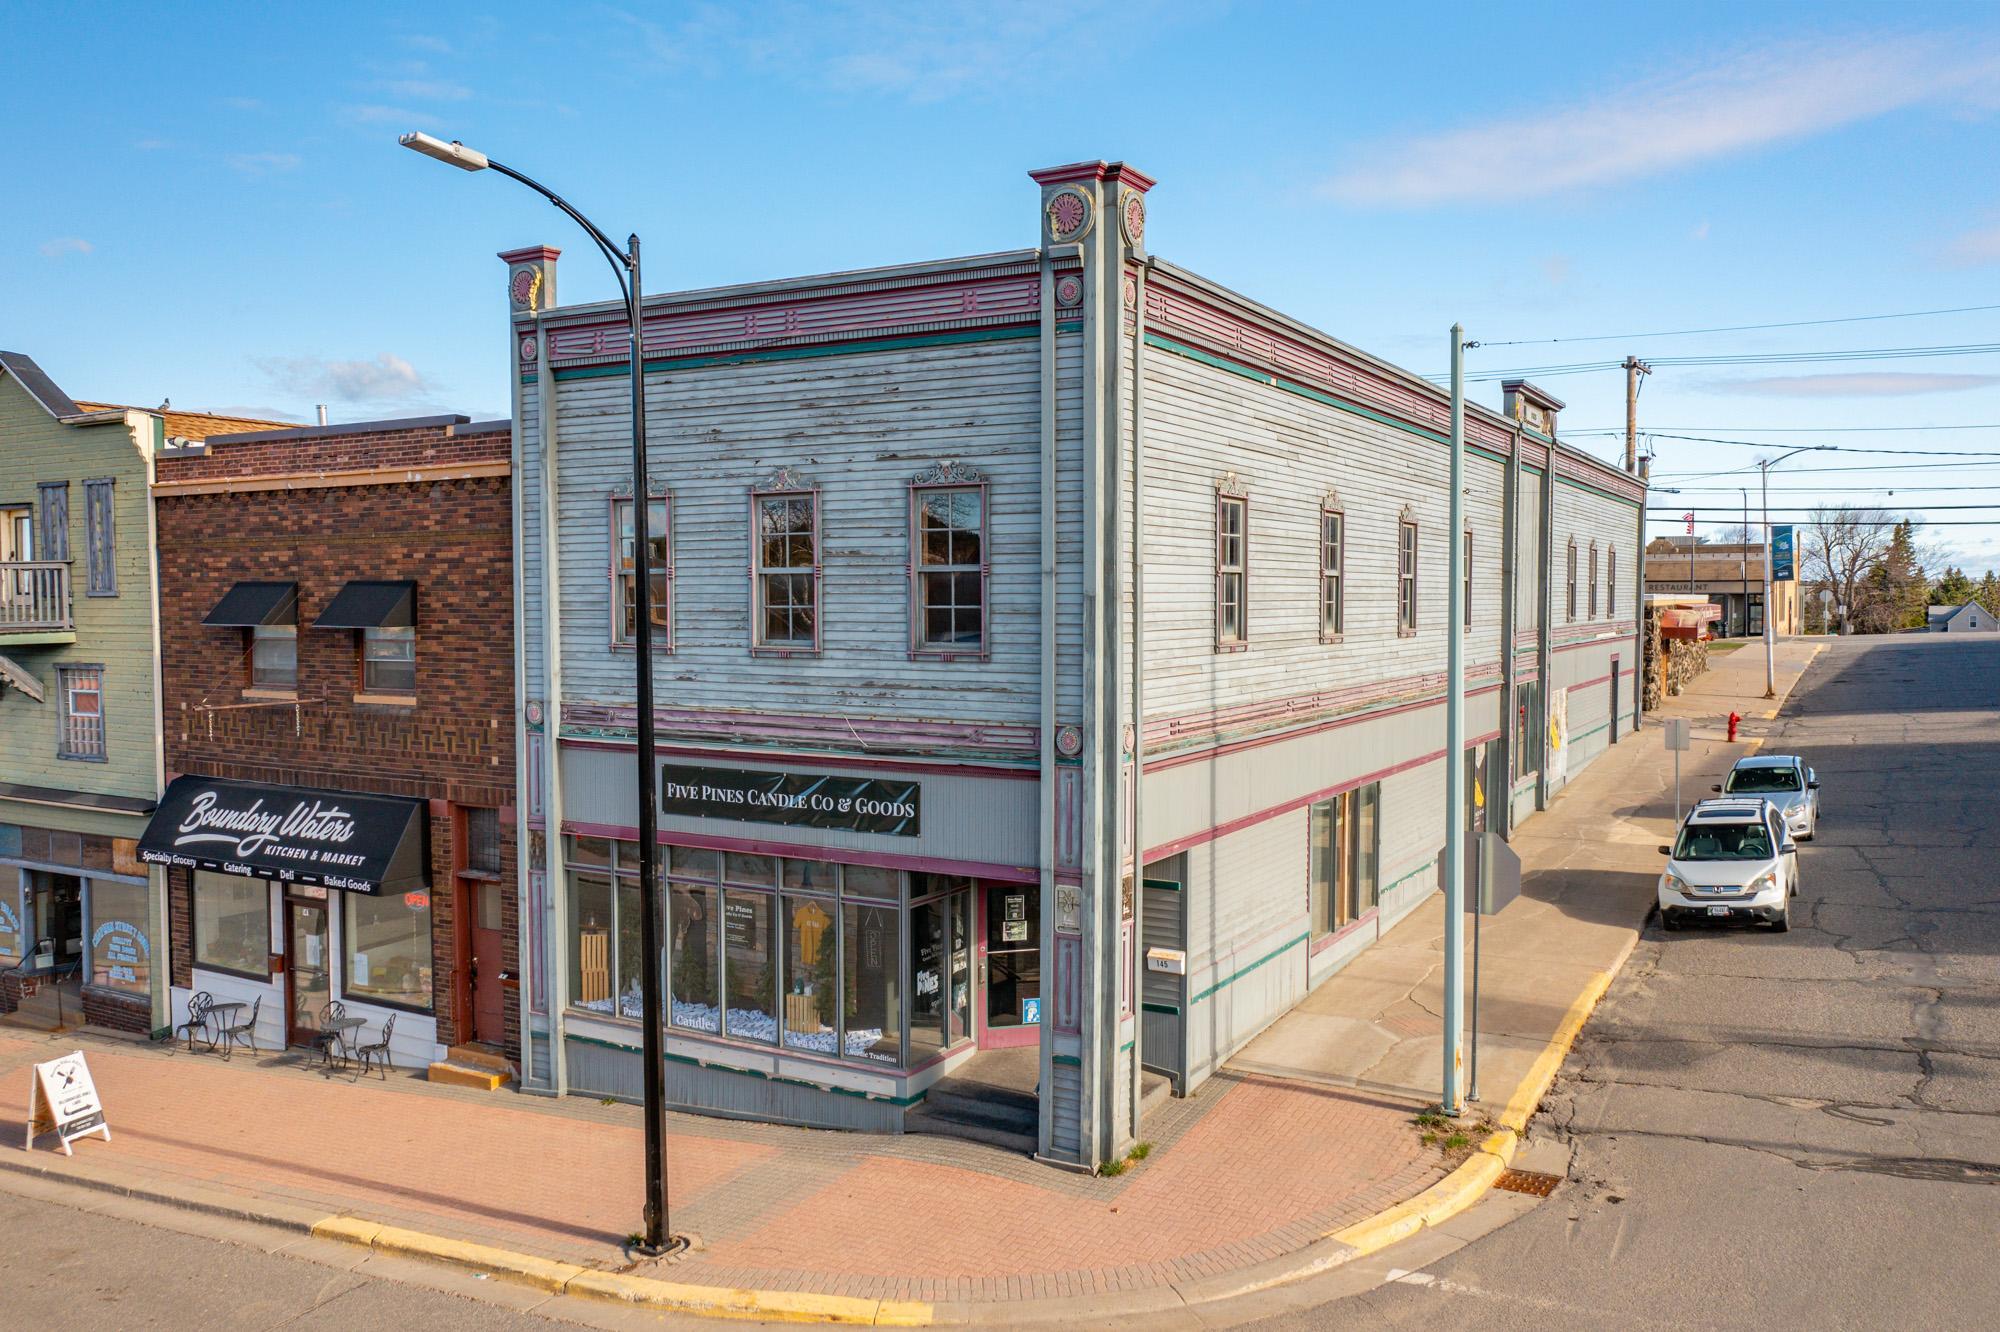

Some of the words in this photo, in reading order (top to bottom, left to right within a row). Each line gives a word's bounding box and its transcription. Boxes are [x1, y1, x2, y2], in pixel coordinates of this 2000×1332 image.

[667, 782, 698, 800] FIVE
[702, 785, 744, 804] PINES
[747, 789, 808, 809] CANDLE
[837, 798, 851, 813] &
[855, 797, 915, 818] GOODS
[175, 791, 280, 857] Boundary
[279, 799, 355, 843] Waters
[142, 850, 172, 865] Specialty
[172, 854, 197, 868] Grocery
[264, 844, 308, 860] KITCHEN
[311, 850, 319, 860] &
[320, 852, 366, 867] MARKET
[223, 862, 252, 877] Catering
[280, 869, 295, 881] Deli
[324, 875, 347, 889] Baked
[347, 879, 371, 892] Goods
[405, 893, 429, 907] OPEN
[1156, 959, 1169, 969] 145
[676, 1014, 717, 1032] Candles
[869, 1052, 897, 1063] Tradition
